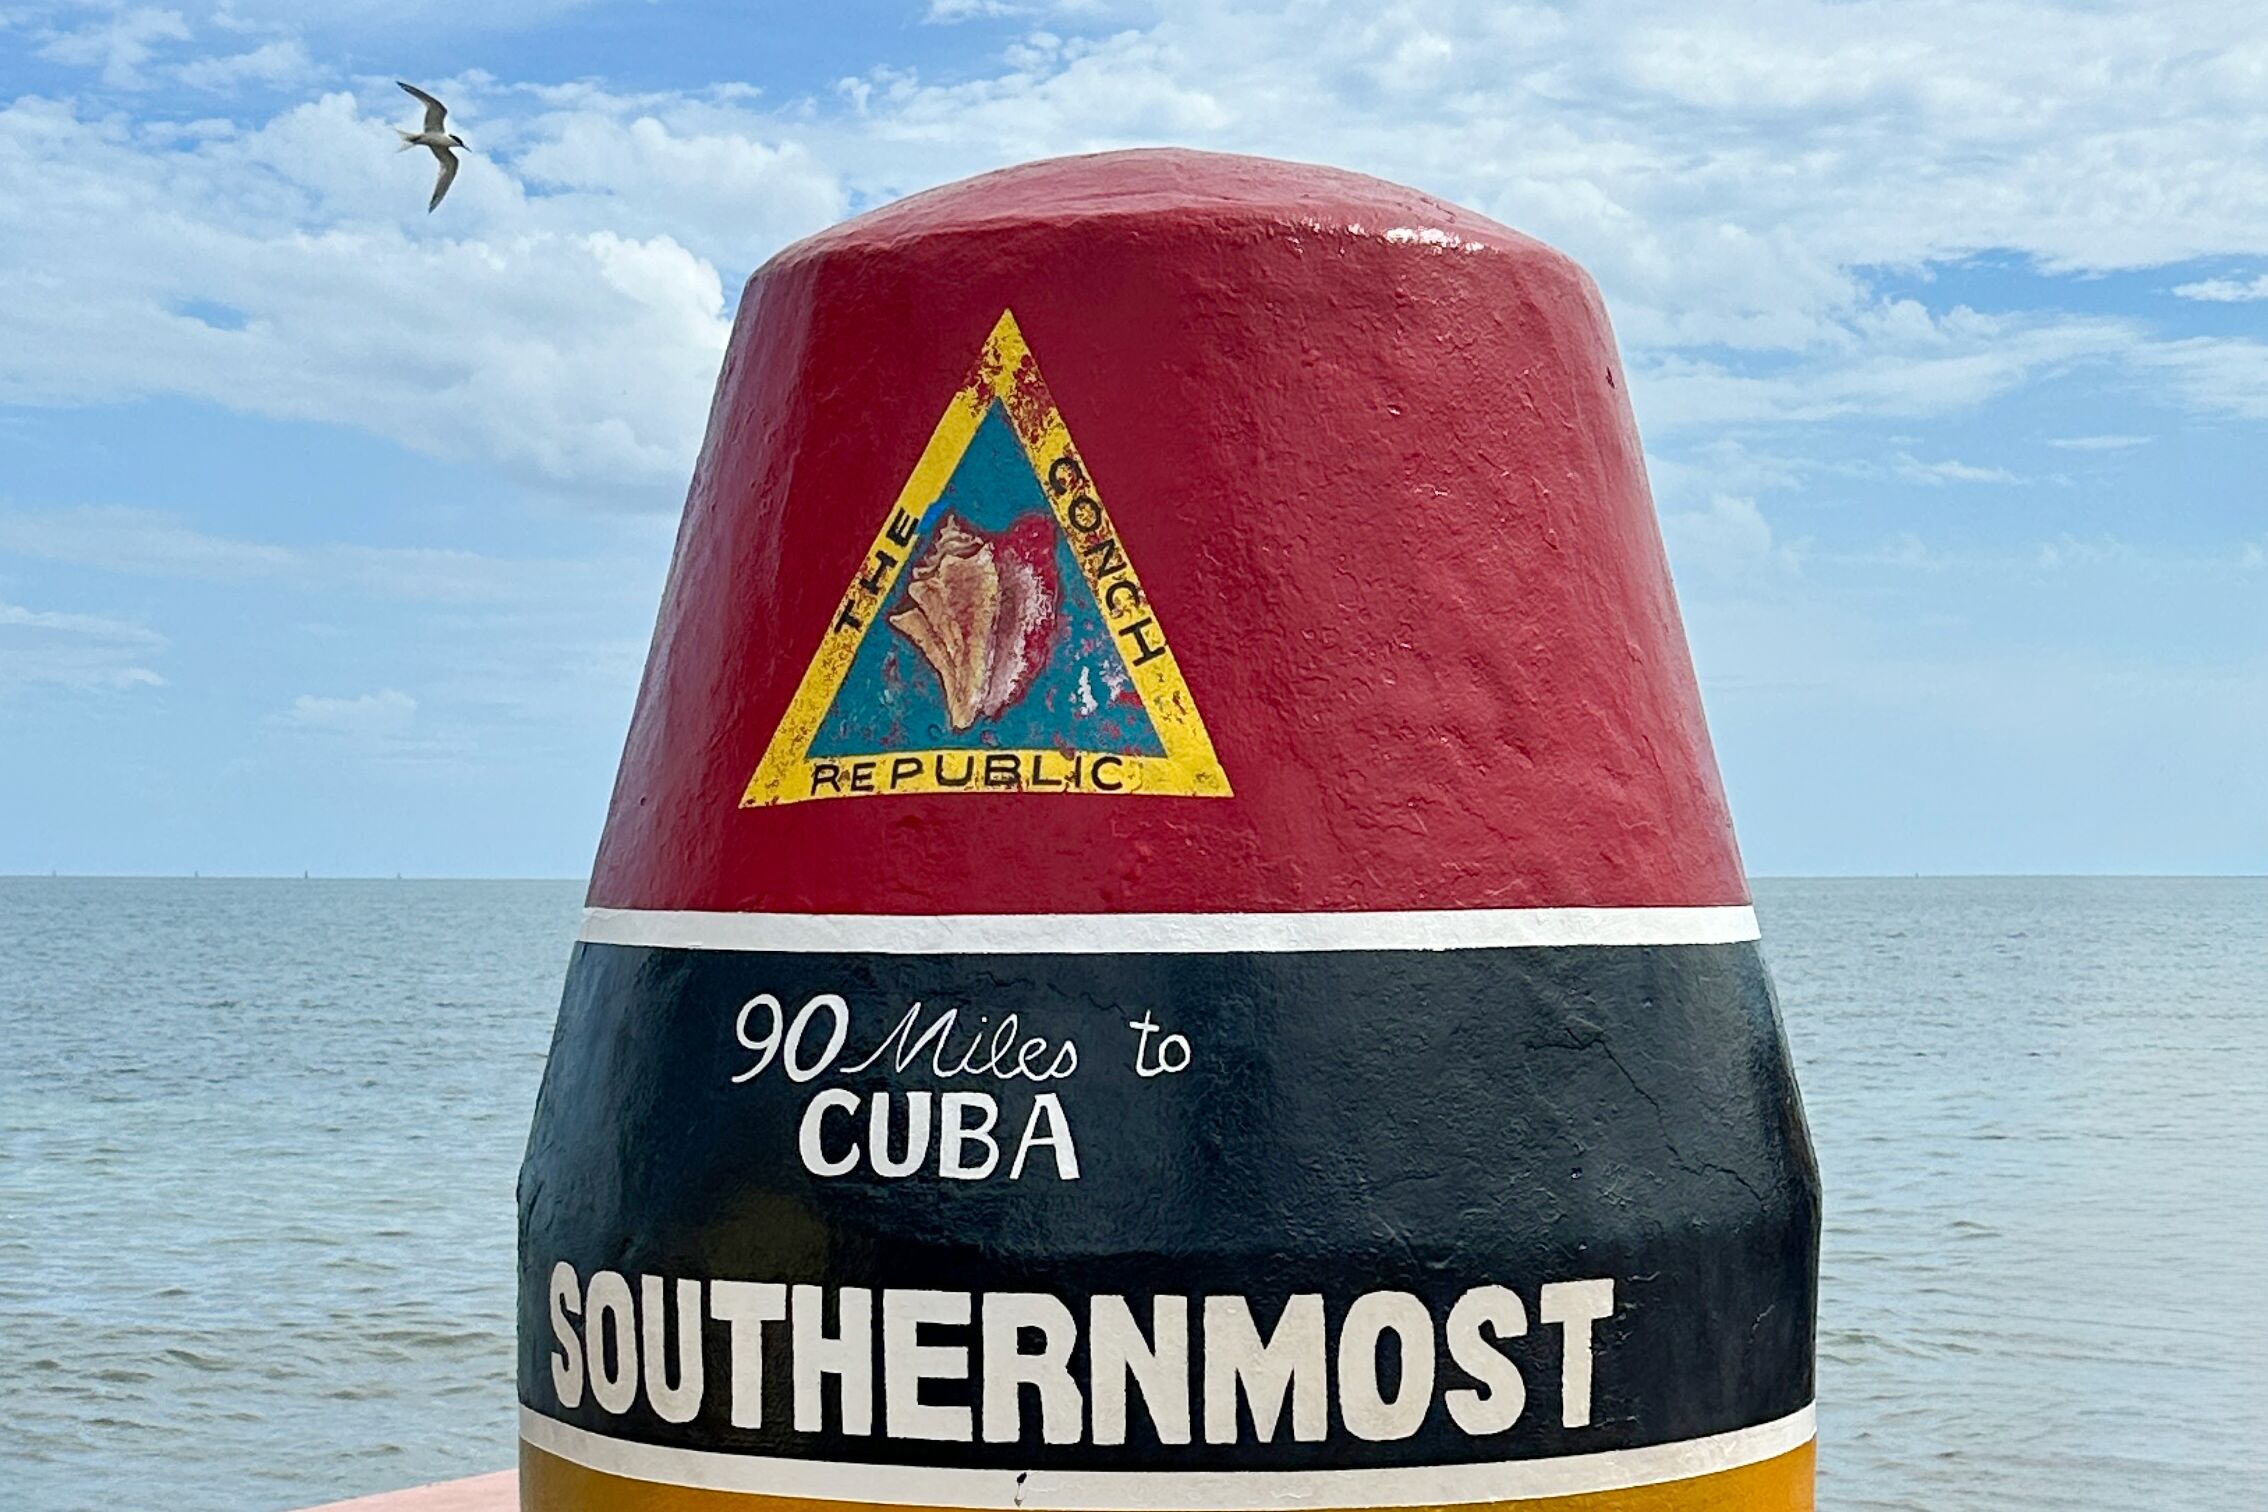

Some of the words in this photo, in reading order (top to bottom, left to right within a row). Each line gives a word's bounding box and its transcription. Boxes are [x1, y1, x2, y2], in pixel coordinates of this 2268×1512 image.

[833, 507, 920, 635] THE
[1048, 457, 1166, 667] CONCH
[811, 752, 1124, 796] REPUBLIC
[731, 993, 850, 1083] 90
[840, 1001, 1078, 1081] Miles
[1129, 1008, 1192, 1077] to
[799, 1087, 1081, 1181] CUBA
[548, 1260, 1615, 1446] SOUTHERNMOST
